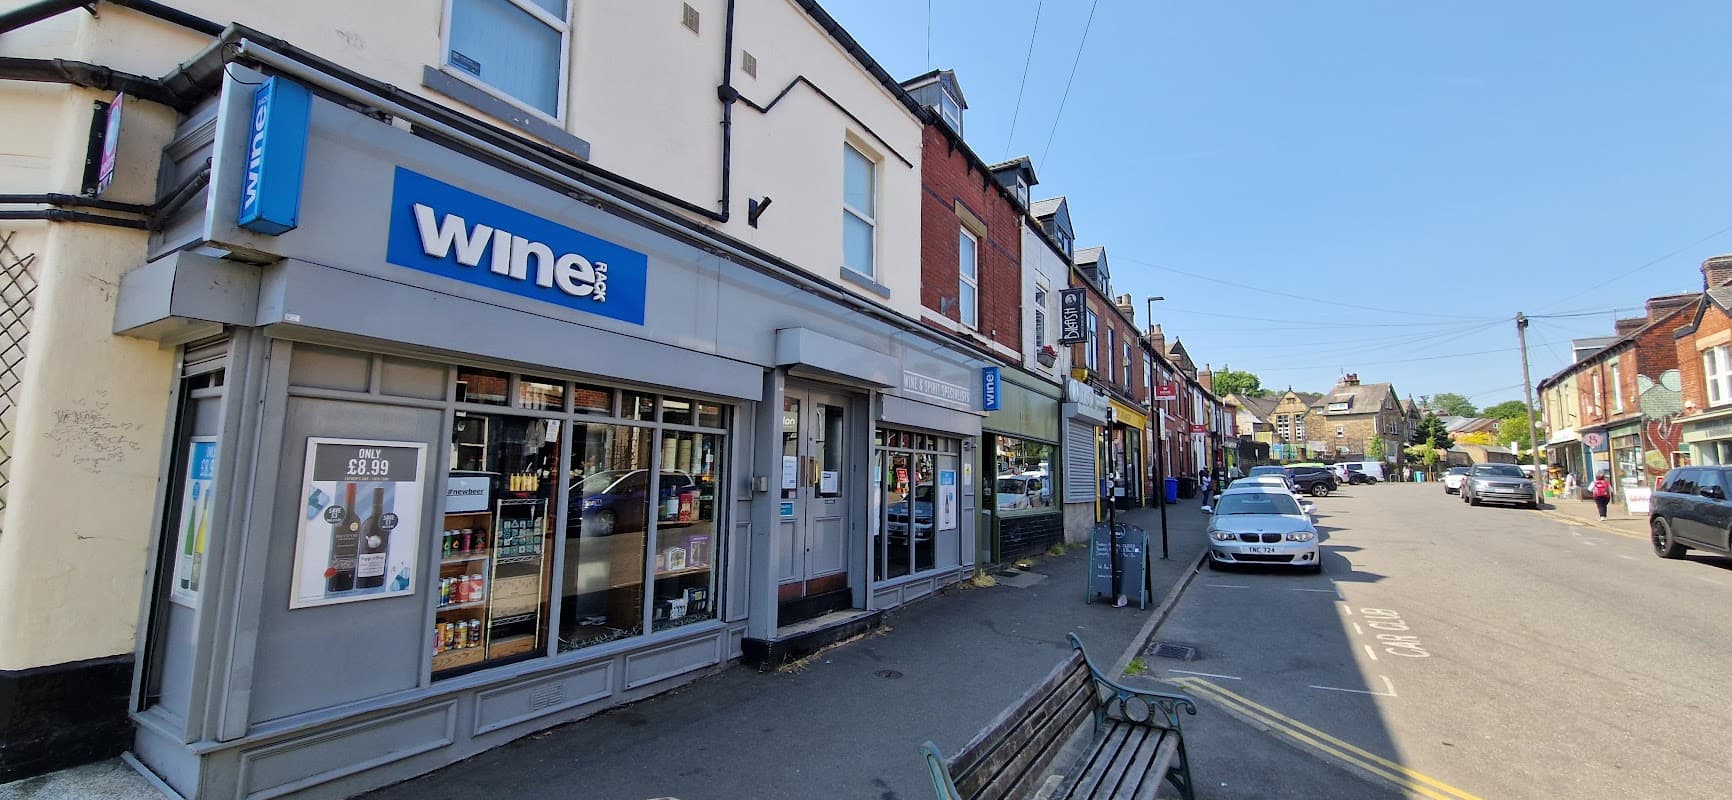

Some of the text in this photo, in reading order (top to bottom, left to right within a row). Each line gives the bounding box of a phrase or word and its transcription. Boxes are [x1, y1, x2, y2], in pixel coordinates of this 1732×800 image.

[243, 103, 268, 210] wine
[412, 202, 608, 303] wine RACK
[903, 373, 970, 403] WINE & SPIRIT SPECIALISTS
[985, 373, 995, 406] wine
[346, 458, 389, 476] £8.99
[358, 448, 382, 459] ONLY
[446, 487, 484, 496] #newbeer
[1360, 607, 1431, 658] CAR CLUB
